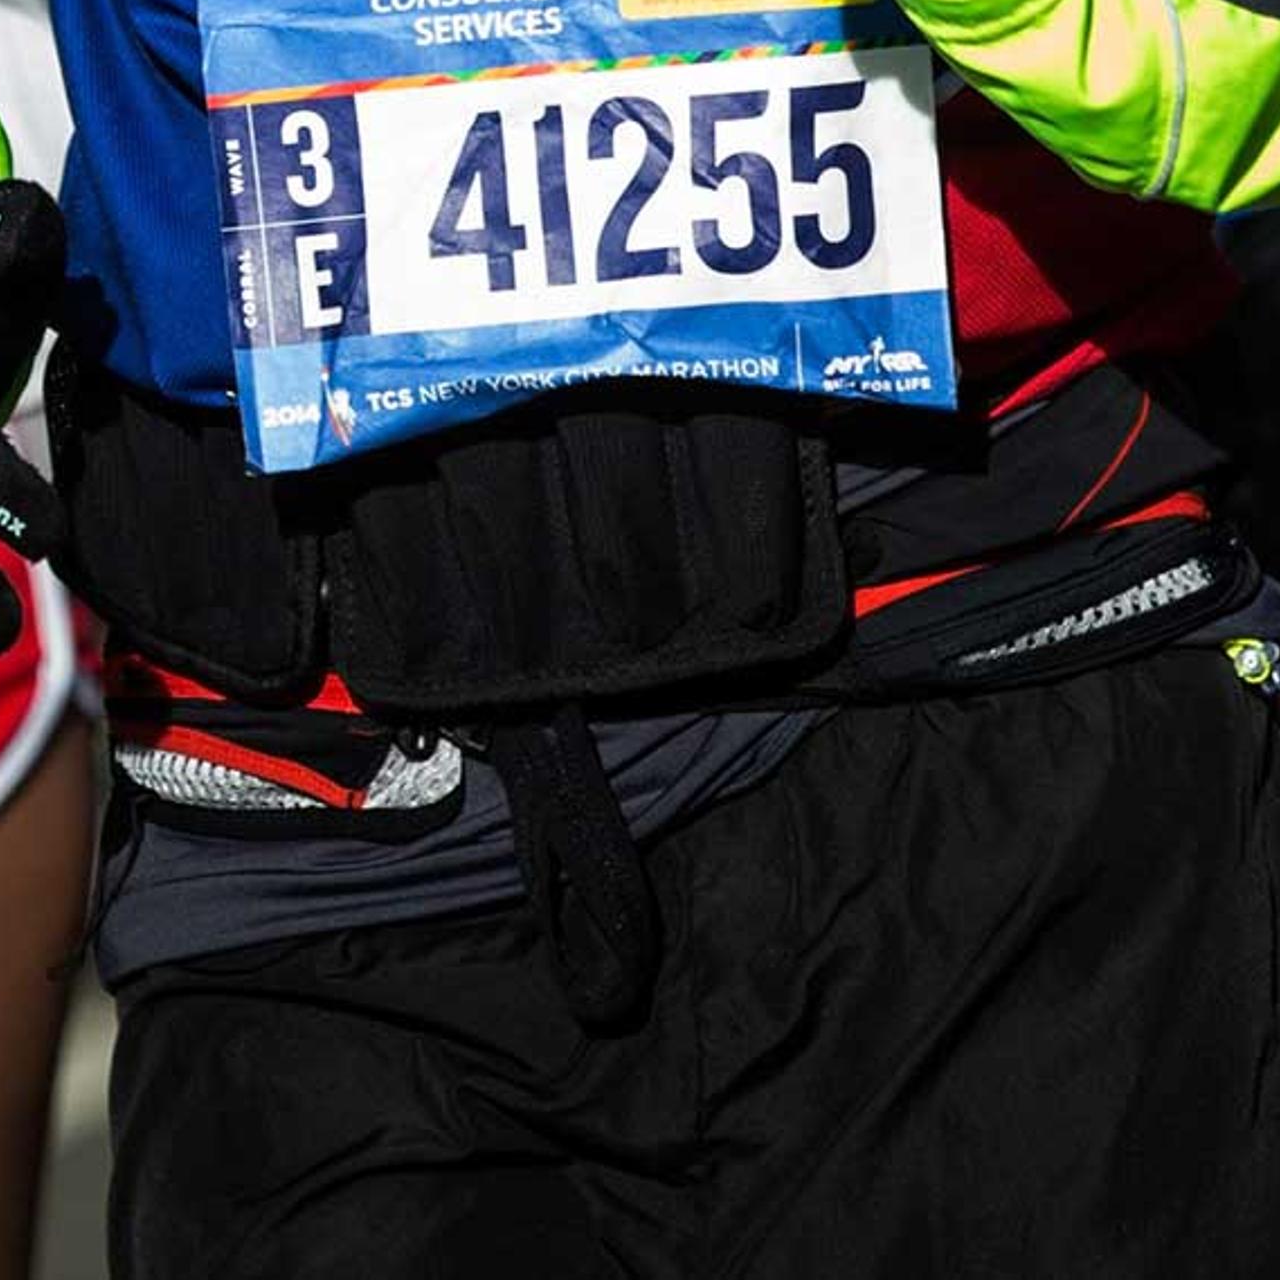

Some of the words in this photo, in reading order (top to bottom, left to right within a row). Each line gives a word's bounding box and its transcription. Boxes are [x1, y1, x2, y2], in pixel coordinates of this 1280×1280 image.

[413, 7, 563, 47] SERVICES
[225, 138, 246, 196] WAVE
[281, 109, 335, 208] 3
[426, 80, 876, 293] 41255
[237, 247, 257, 329] CORRAL
[295, 232, 344, 330] E
[262, 403, 320, 429] 2014
[365, 387, 415, 412] TCS
[418, 377, 479, 405] NEW
[484, 371, 556, 392] YORK
[630, 355, 780, 380] MARATHON
[860, 379, 893, 392] FOR
[895, 376, 931, 391] LIFE
